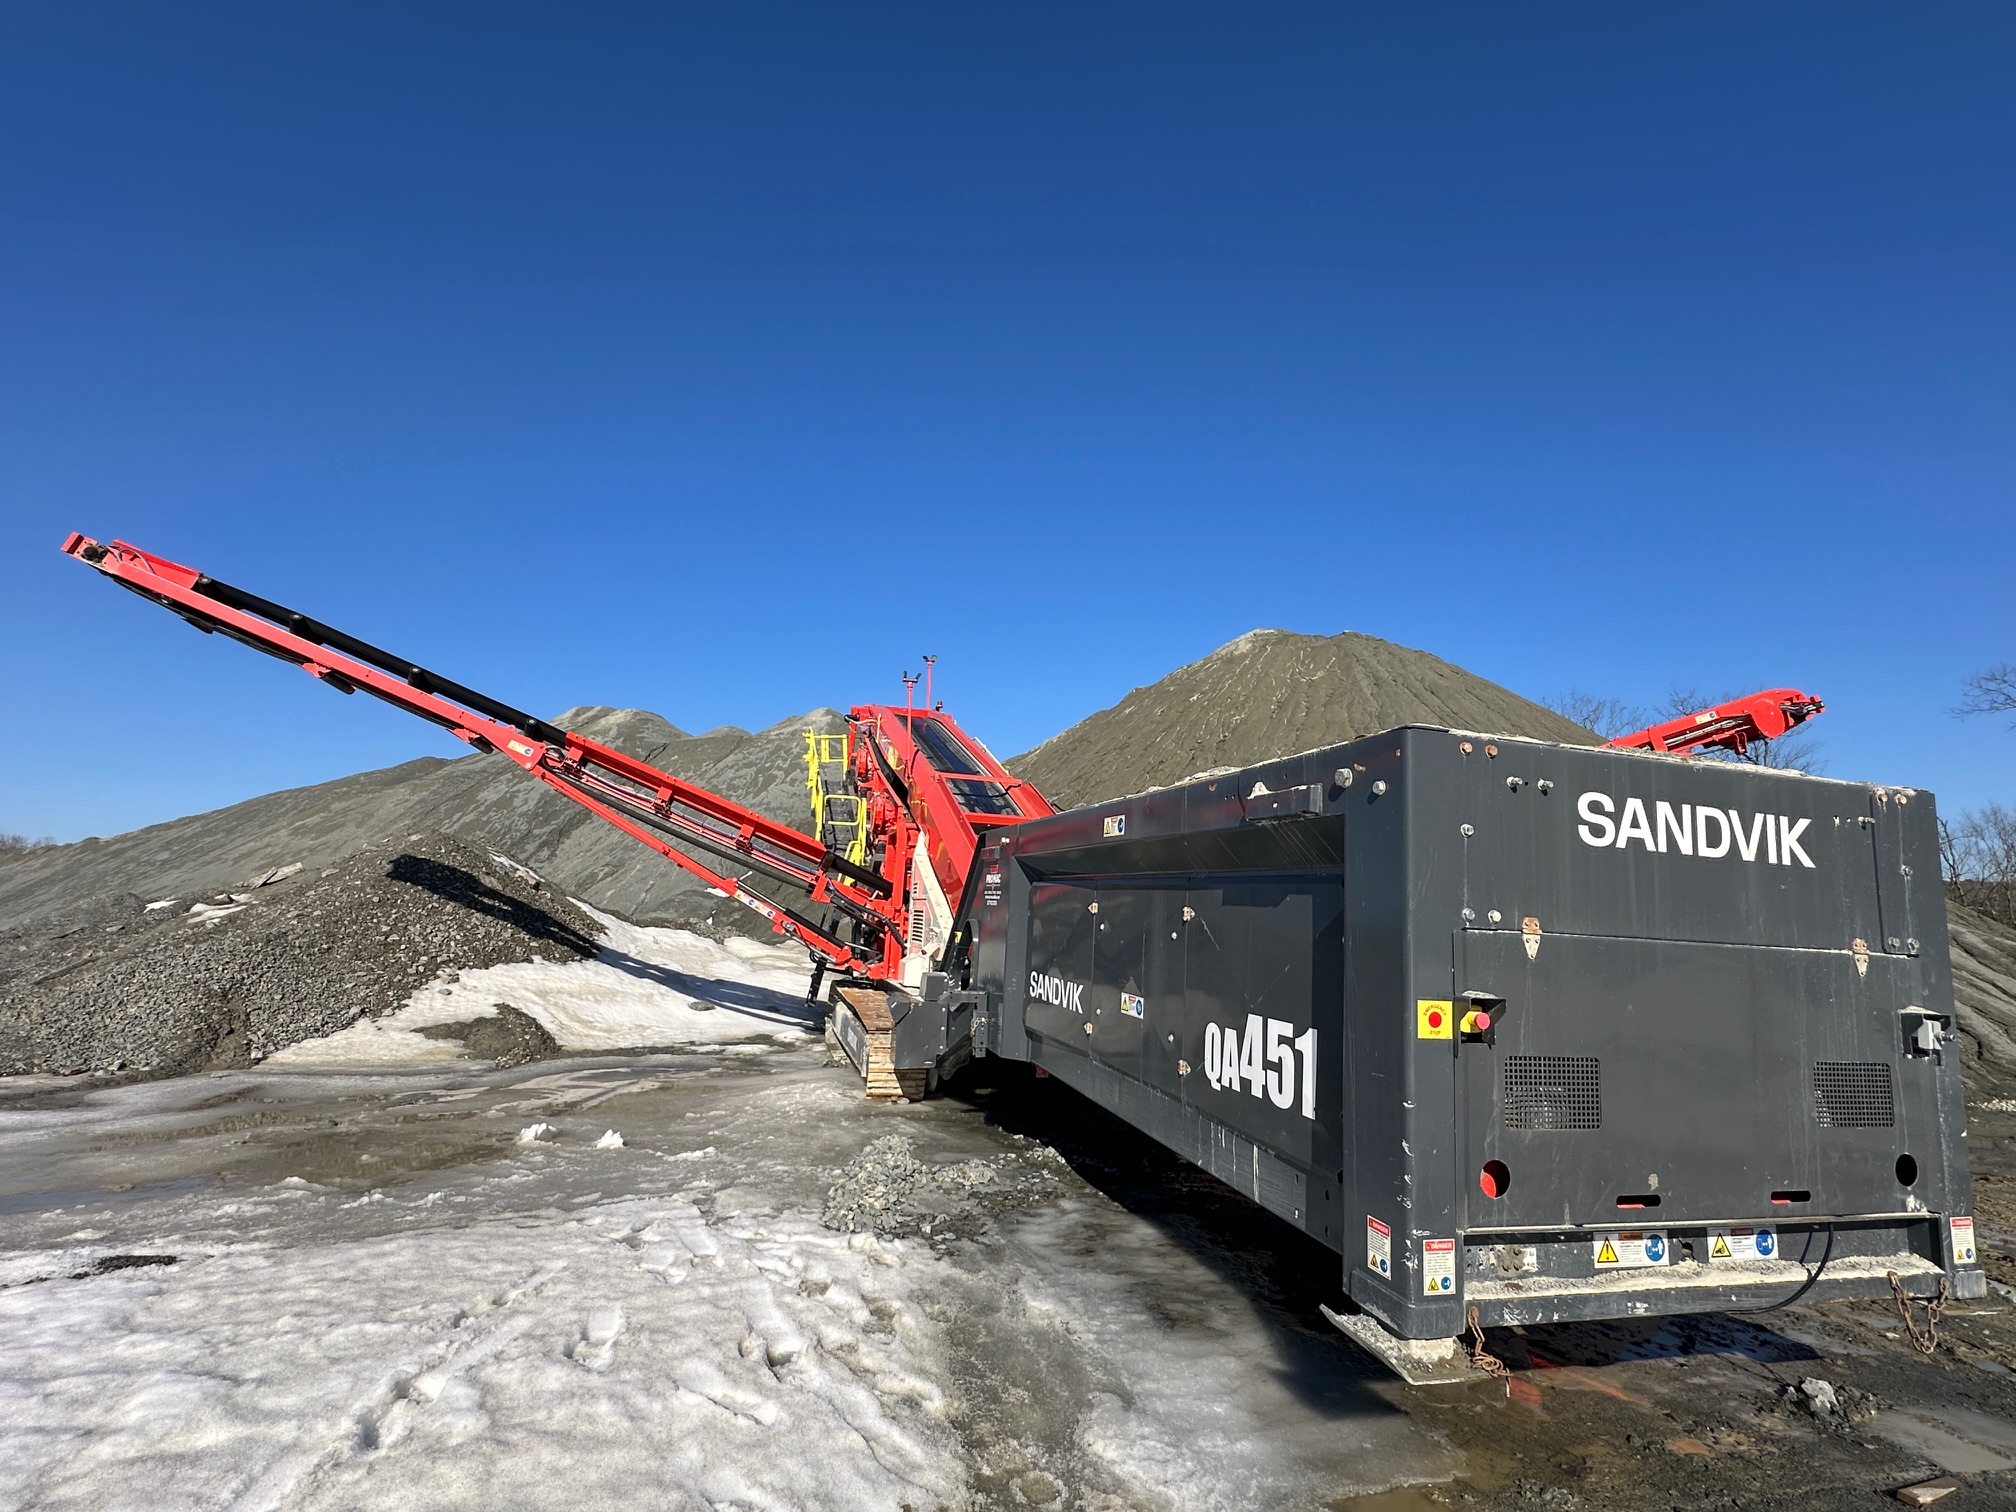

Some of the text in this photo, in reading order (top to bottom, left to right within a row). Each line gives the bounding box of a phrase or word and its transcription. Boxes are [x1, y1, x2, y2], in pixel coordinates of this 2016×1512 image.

[1577, 791, 1816, 868] SANDVIK
[1029, 970, 1084, 1014] SANDVIK
[1423, 1004, 1447, 1016] EMERGENCY
[1204, 1013, 1318, 1120] QA451
